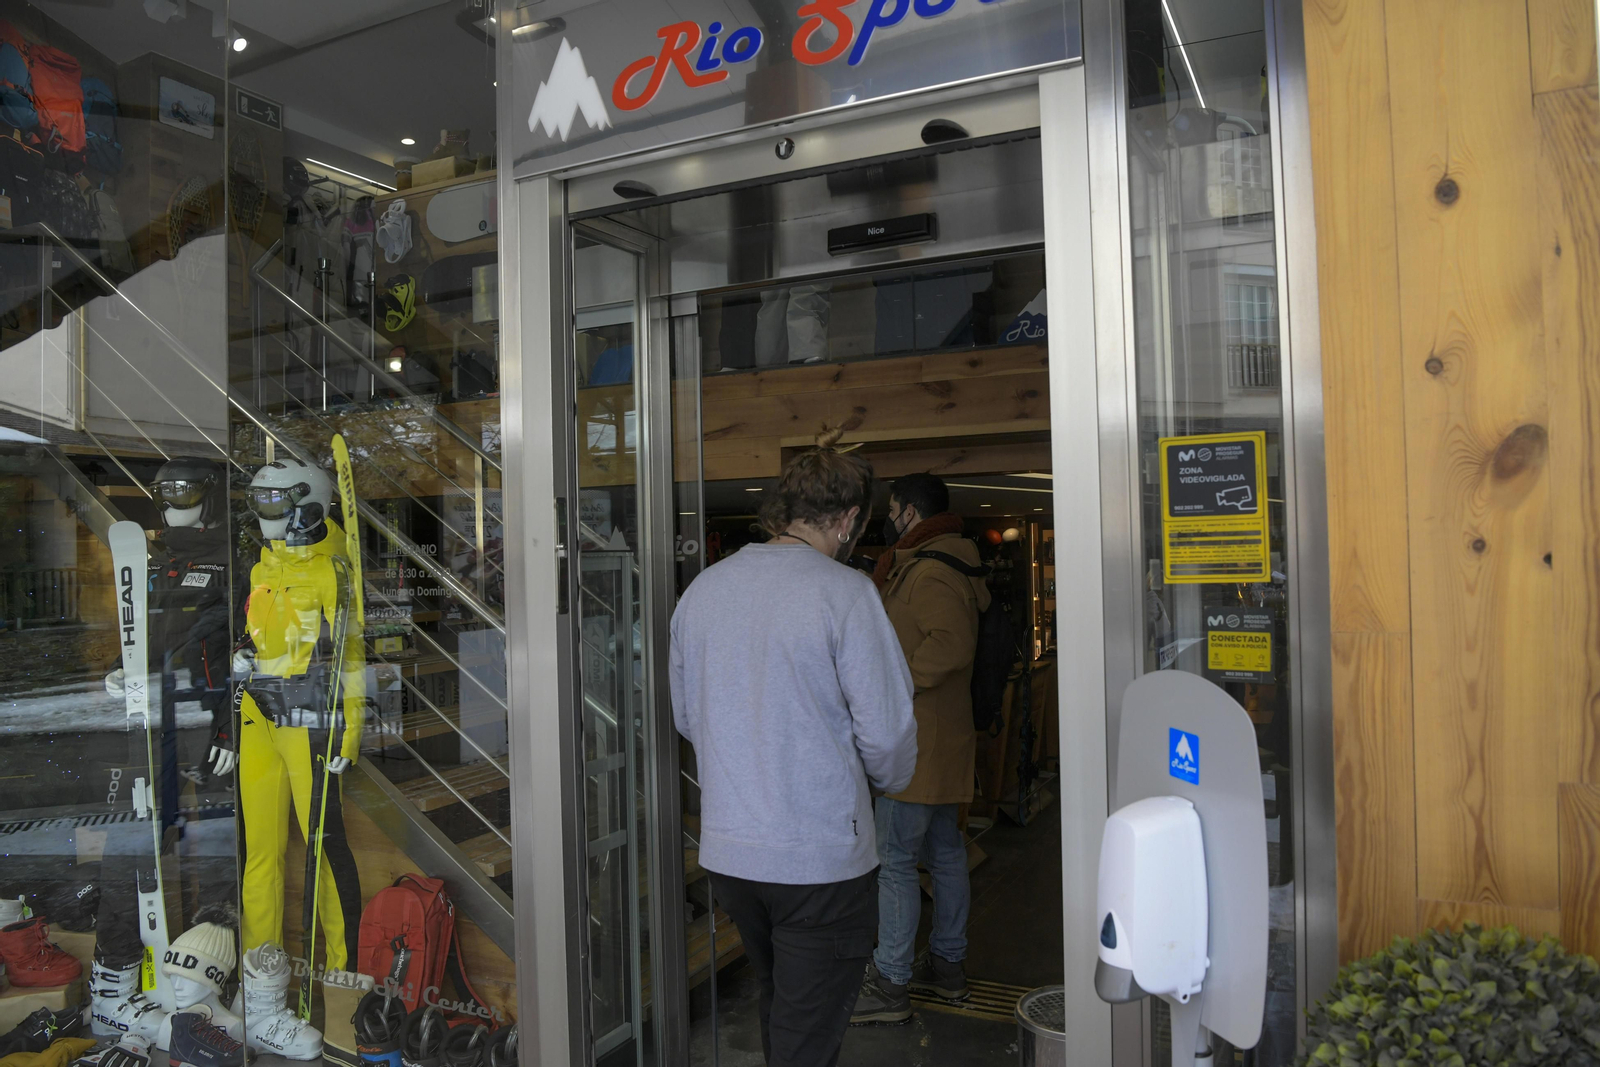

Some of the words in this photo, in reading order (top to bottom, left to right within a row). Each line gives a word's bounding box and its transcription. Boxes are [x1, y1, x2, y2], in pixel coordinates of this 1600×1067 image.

[612, 20, 765, 111] Rio
[867, 227, 885, 235] Nice
[1006, 320, 1046, 342] Rio
[1179, 467, 1203, 475] ZONA
[1179, 474, 1246, 484] VIDEOVIGILADA
[675, 534, 699, 561] io
[385, 568, 396, 578] de
[398, 568, 417, 578] 8:30
[121, 566, 136, 647] HEAD
[1210, 634, 1268, 643] CONECTADA
[164, 950, 199, 969] OLD
[292, 956, 366, 991] British
[373, 977, 415, 1003] Ski
[423, 985, 505, 1022] Center
[91, 1011, 130, 1032] HEAD
[255, 1034, 284, 1051] HEAD
